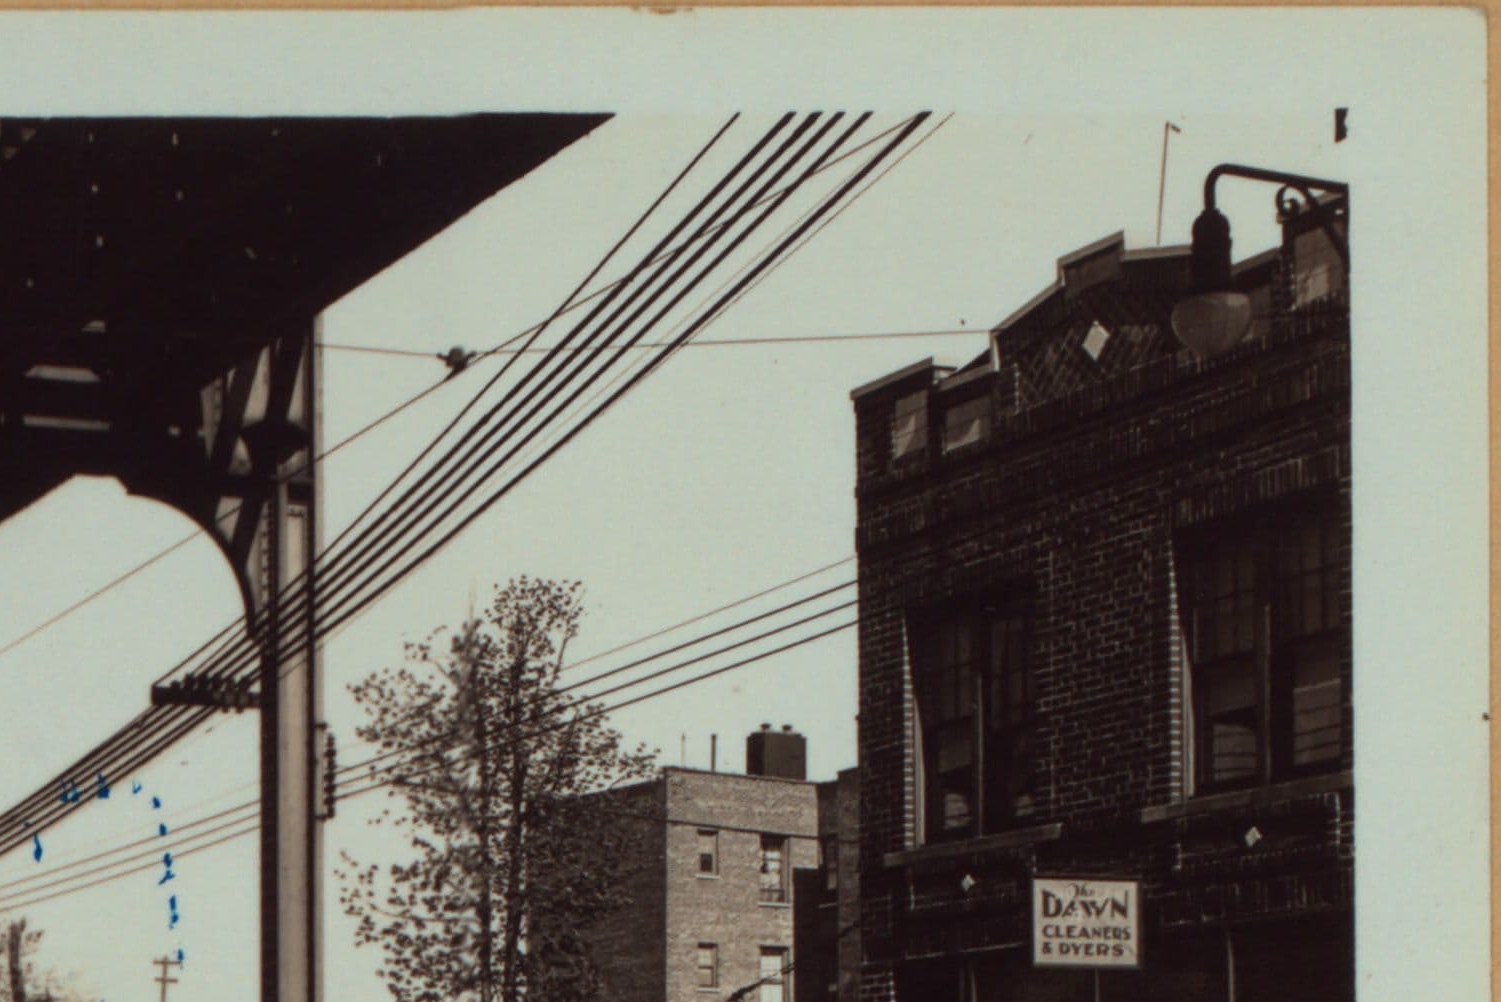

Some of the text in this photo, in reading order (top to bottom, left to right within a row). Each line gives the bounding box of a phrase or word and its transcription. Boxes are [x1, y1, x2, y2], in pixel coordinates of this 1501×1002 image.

[1042, 887, 1128, 918] DAWN
[1041, 924, 1132, 941] CLEANERS
[1059, 942, 1125, 957] DYERS
